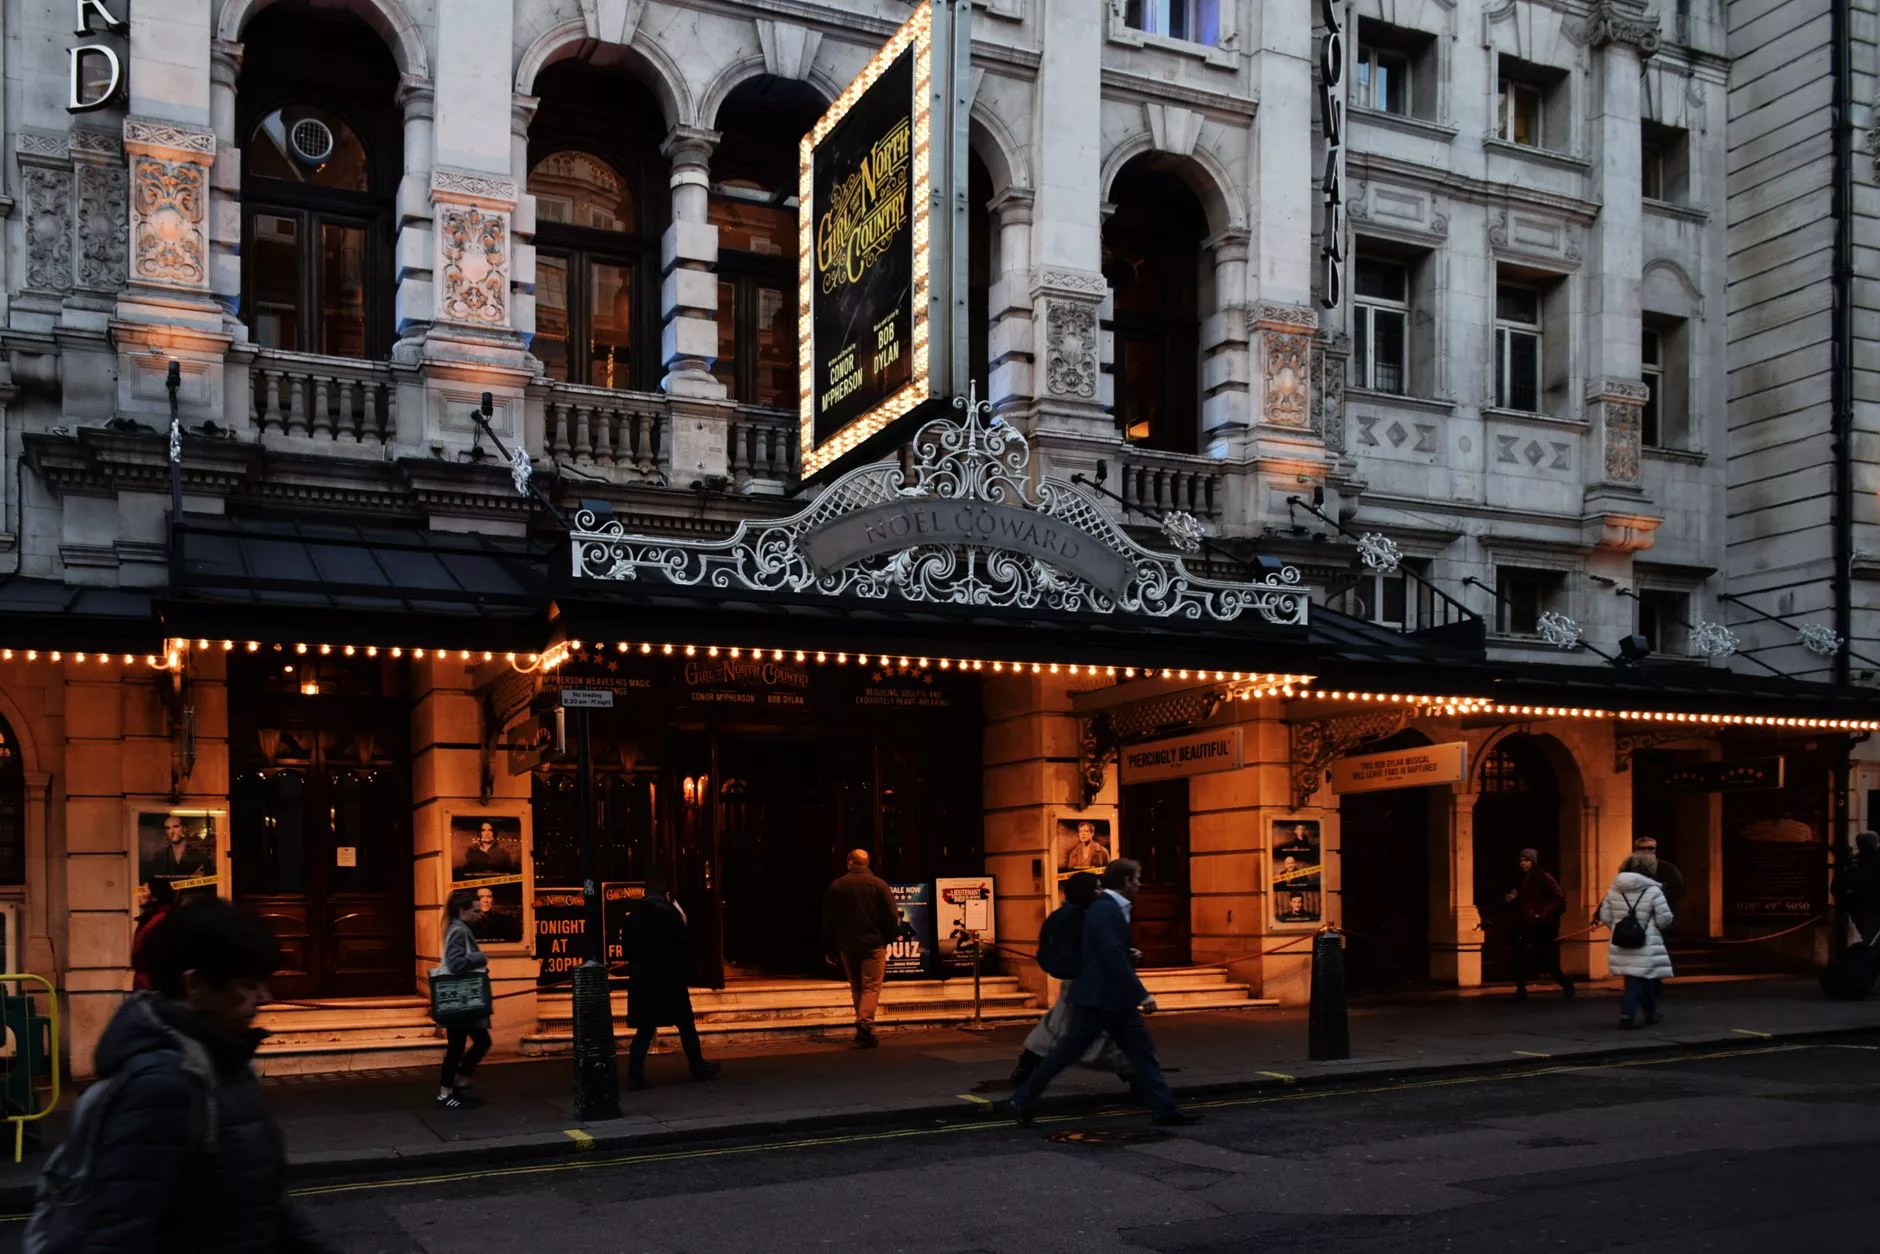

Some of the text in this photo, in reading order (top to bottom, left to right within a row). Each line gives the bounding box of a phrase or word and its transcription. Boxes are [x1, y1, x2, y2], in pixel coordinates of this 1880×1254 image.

[860, 126, 911, 217] NORTH
[817, 208, 852, 272] GIRL
[846, 187, 908, 283] COUNTRY
[878, 321, 895, 350] BOB
[873, 340, 899, 375] DYLAN
[830, 353, 854, 386] CONOR
[954, 511, 1080, 560] COWARD
[723, 658, 760, 683] NORTH
[761, 661, 811, 688] COUNTRY
[586, 676, 614, 686] WEAVES
[629, 679, 651, 688] MAGIC
[690, 692, 714, 702] CONOR
[767, 695, 804, 705] BOB DYLAN
[1386, 758, 1404, 768] DYLAN
[1405, 754, 1430, 765] MUSICAL
[1384, 767, 1399, 777] FANS
[906, 886, 921, 894] NOW
[1784, 900, 1811, 911] 5050
[535, 919, 587, 935] TONIGHT
[551, 938, 569, 953] AT
